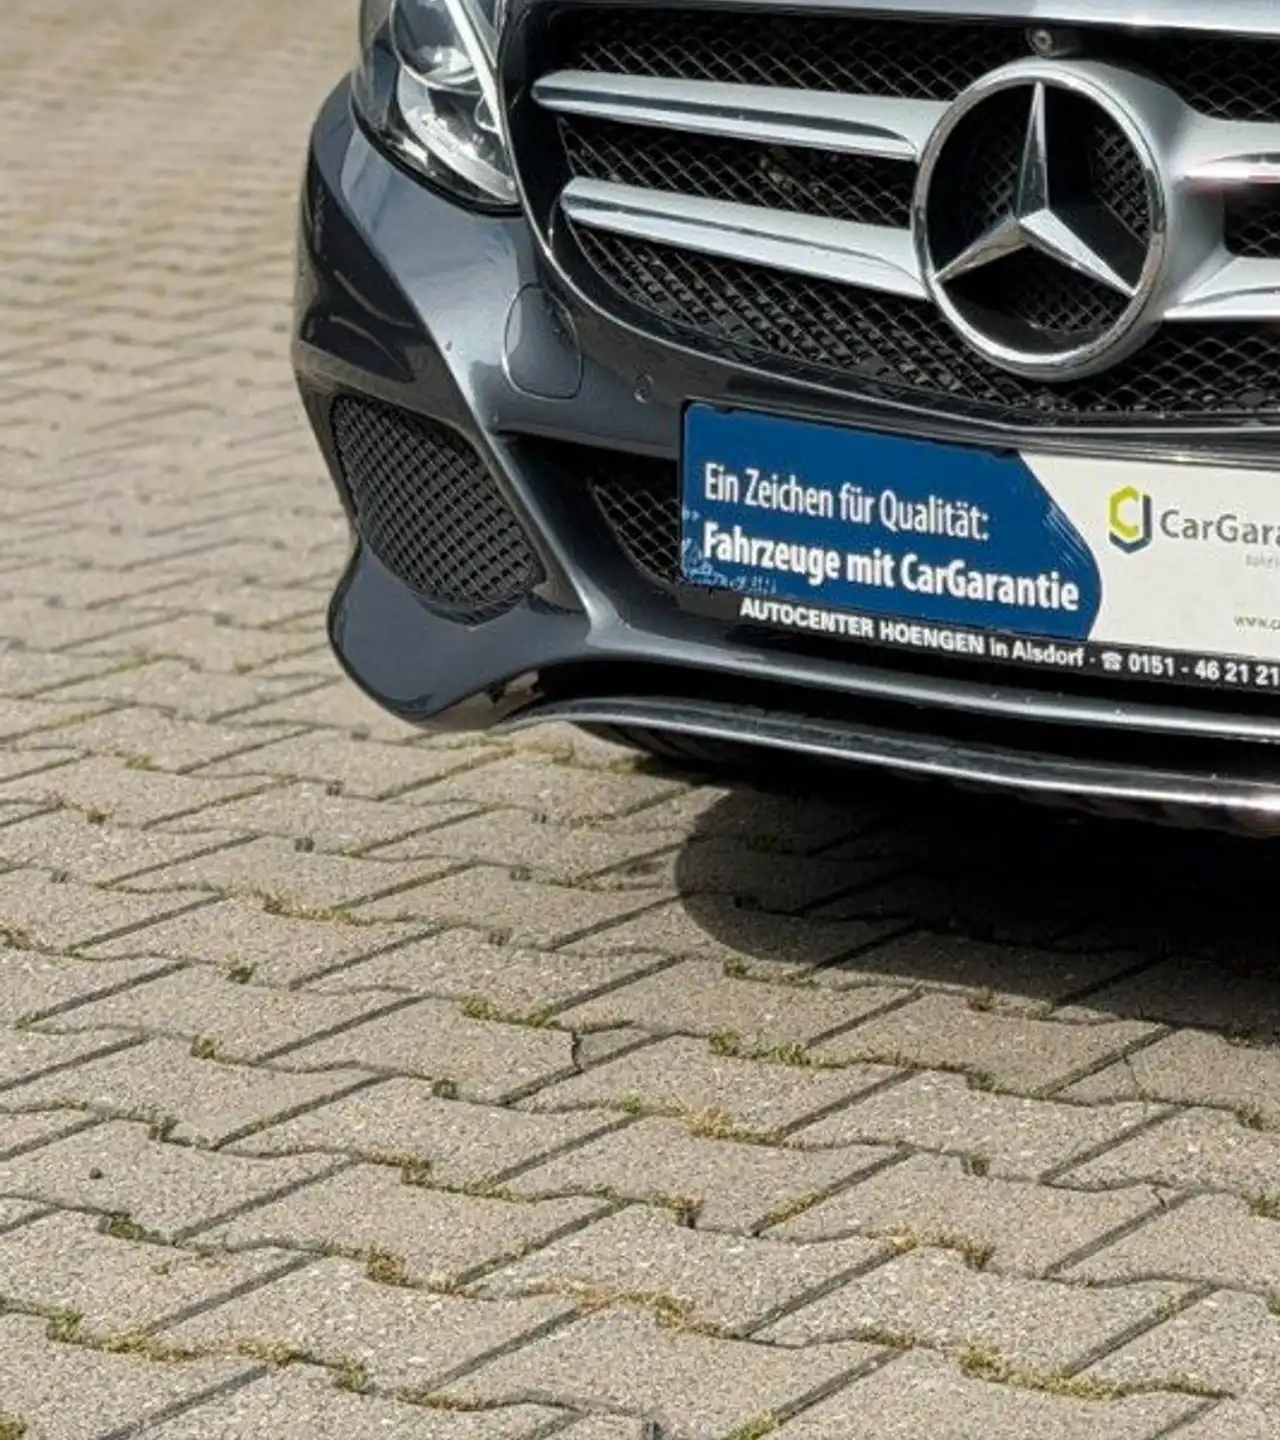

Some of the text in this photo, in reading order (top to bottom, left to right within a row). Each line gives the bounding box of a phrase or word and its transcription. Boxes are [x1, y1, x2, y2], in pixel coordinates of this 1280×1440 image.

[704, 461, 990, 541] Ein Zeichen für Qualität:
[703, 520, 1080, 611] Fahrzeuge mit CarGarantie
[739, 596, 874, 638] AUTOCENTER
[879, 620, 984, 655] HOENGEN
[988, 637, 1009, 658] in
[1012, 641, 1085, 667] Alsdorf
[1128, 653, 1175, 677] 0151
[1195, 664, 1220, 681] 46
[1224, 664, 1250, 683] 21
[1255, 666, 1280, 686] 21
